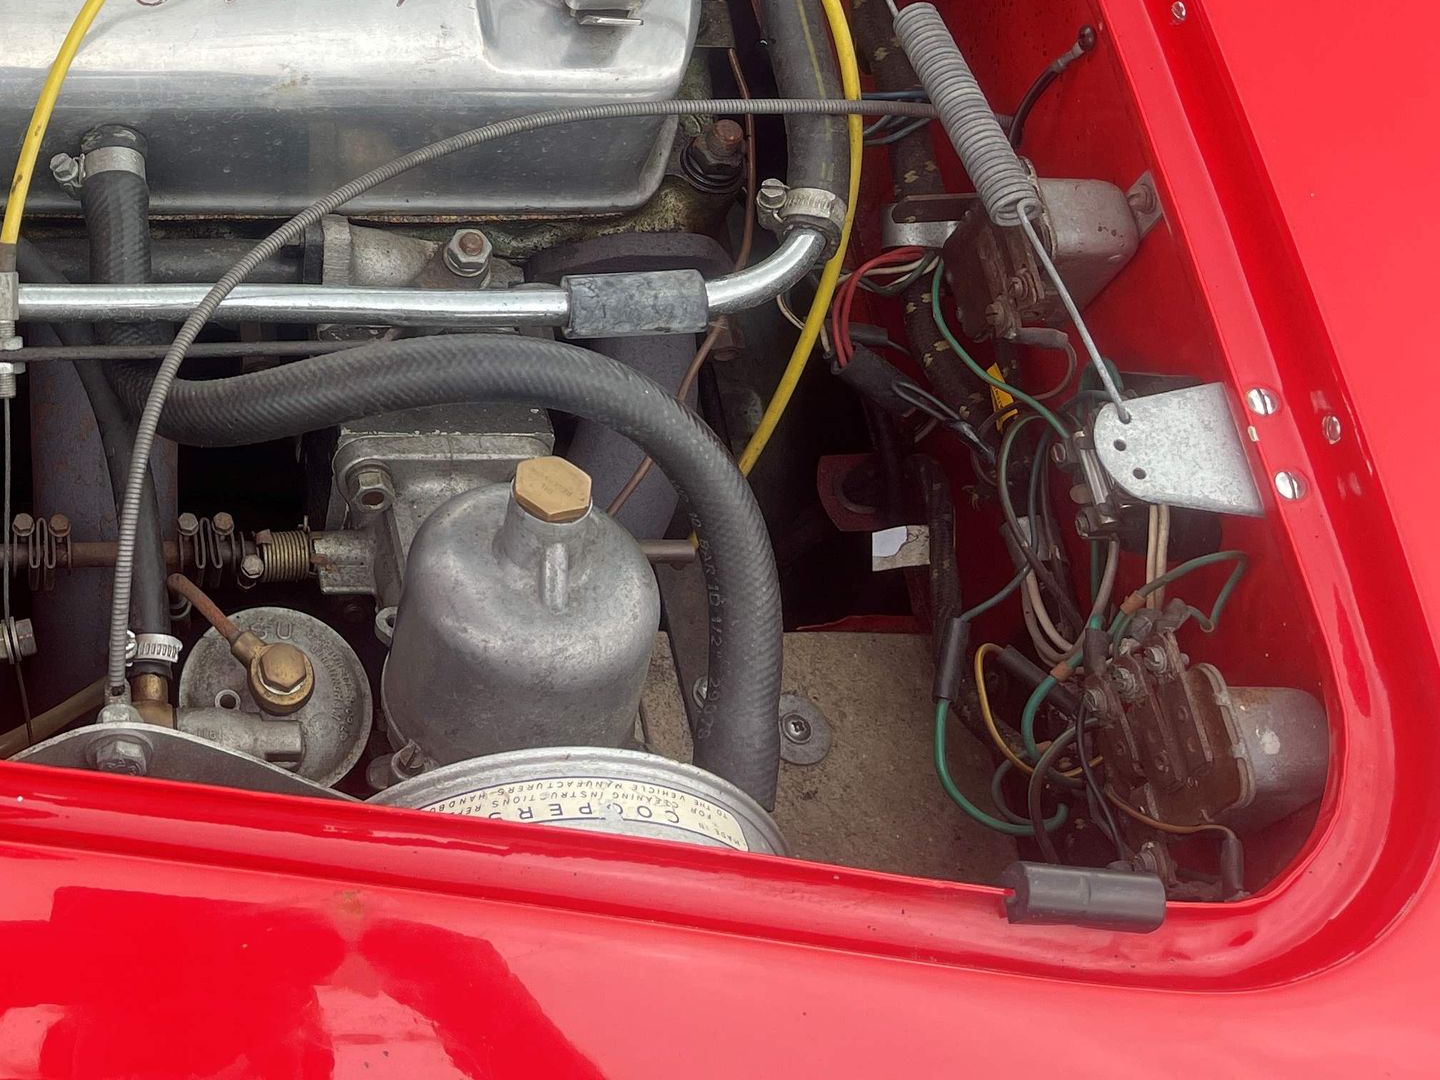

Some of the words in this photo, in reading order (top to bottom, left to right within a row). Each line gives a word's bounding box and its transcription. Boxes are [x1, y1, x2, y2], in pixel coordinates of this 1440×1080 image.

[491, 790, 604, 808] INSTRUCTIONS
[611, 791, 679, 809] CLEANING
[630, 783, 686, 803] VEHICLE
[692, 799, 712, 811] THE
[690, 807, 712, 820] FOR
[716, 808, 729, 819] TO
[697, 822, 709, 832] IN
[714, 829, 742, 846] MADE
